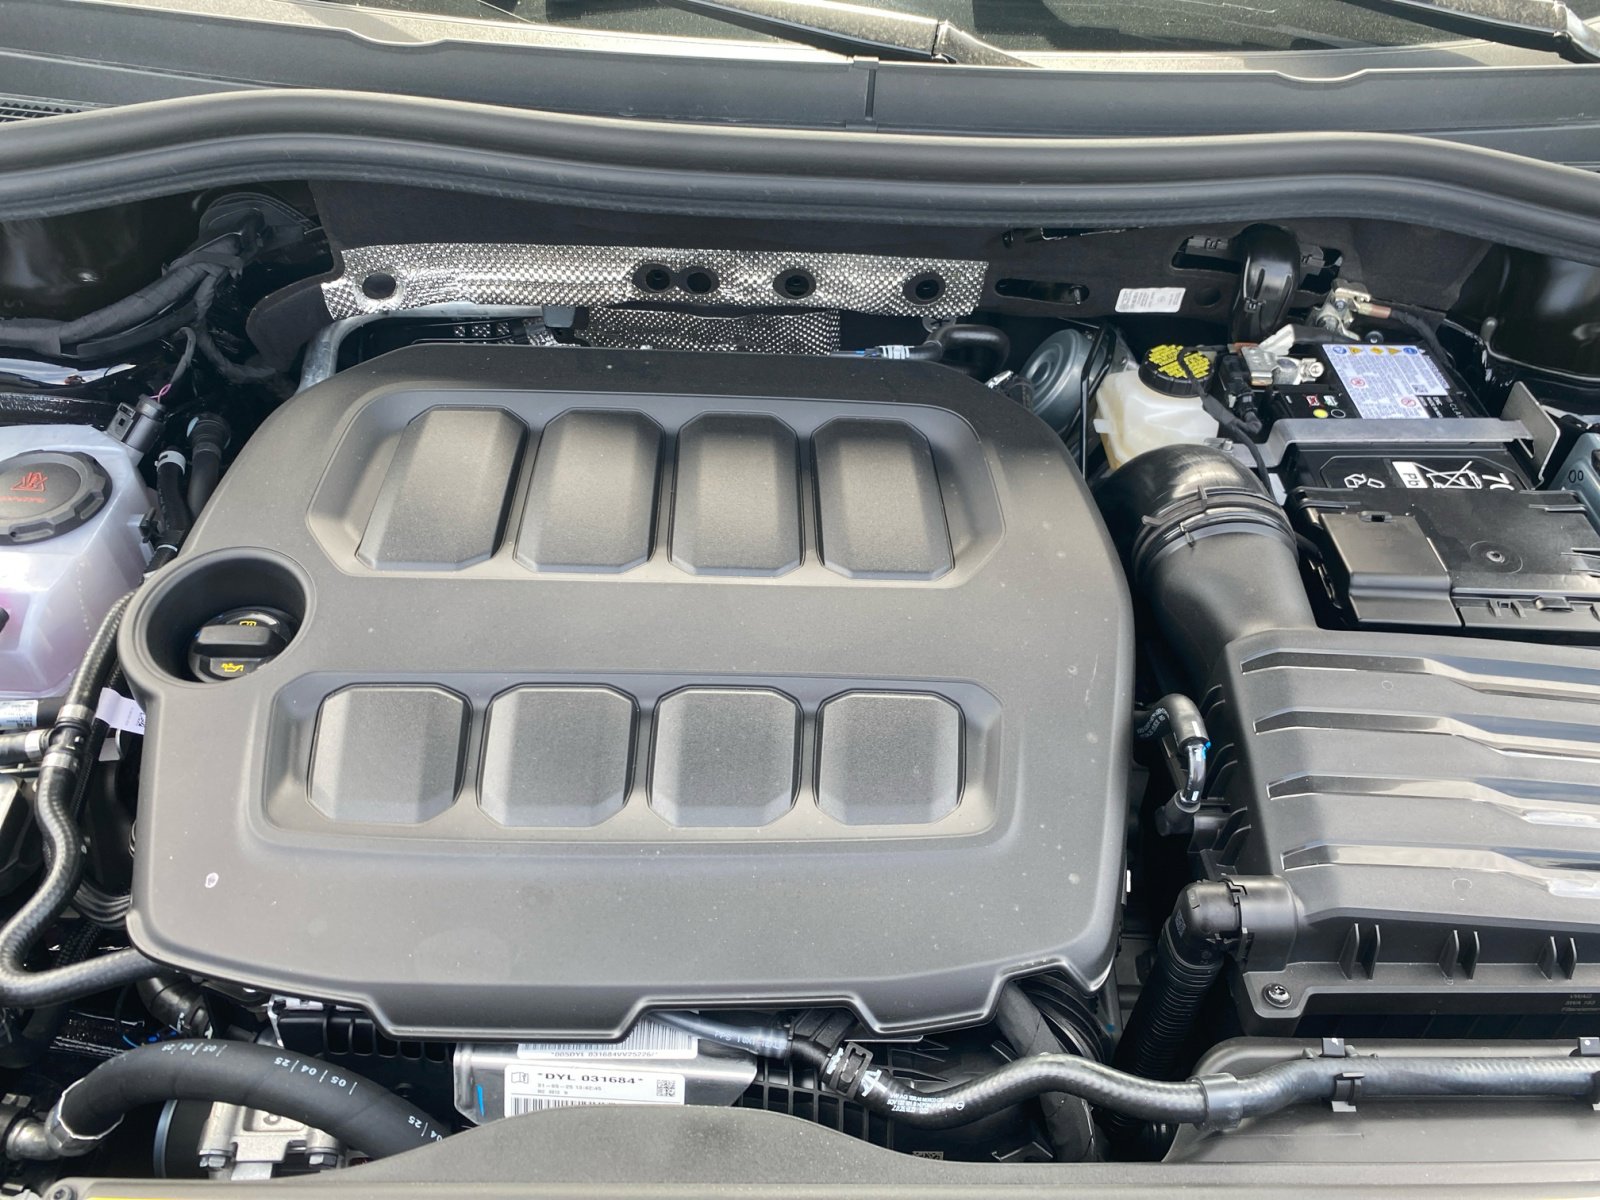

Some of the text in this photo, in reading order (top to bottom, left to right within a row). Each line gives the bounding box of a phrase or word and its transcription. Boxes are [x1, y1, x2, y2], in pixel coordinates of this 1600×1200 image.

[1403, 472, 1420, 488] Pb
[274, 1056, 347, 1087] 05 04 25
[408, 1115, 422, 1128] 25
